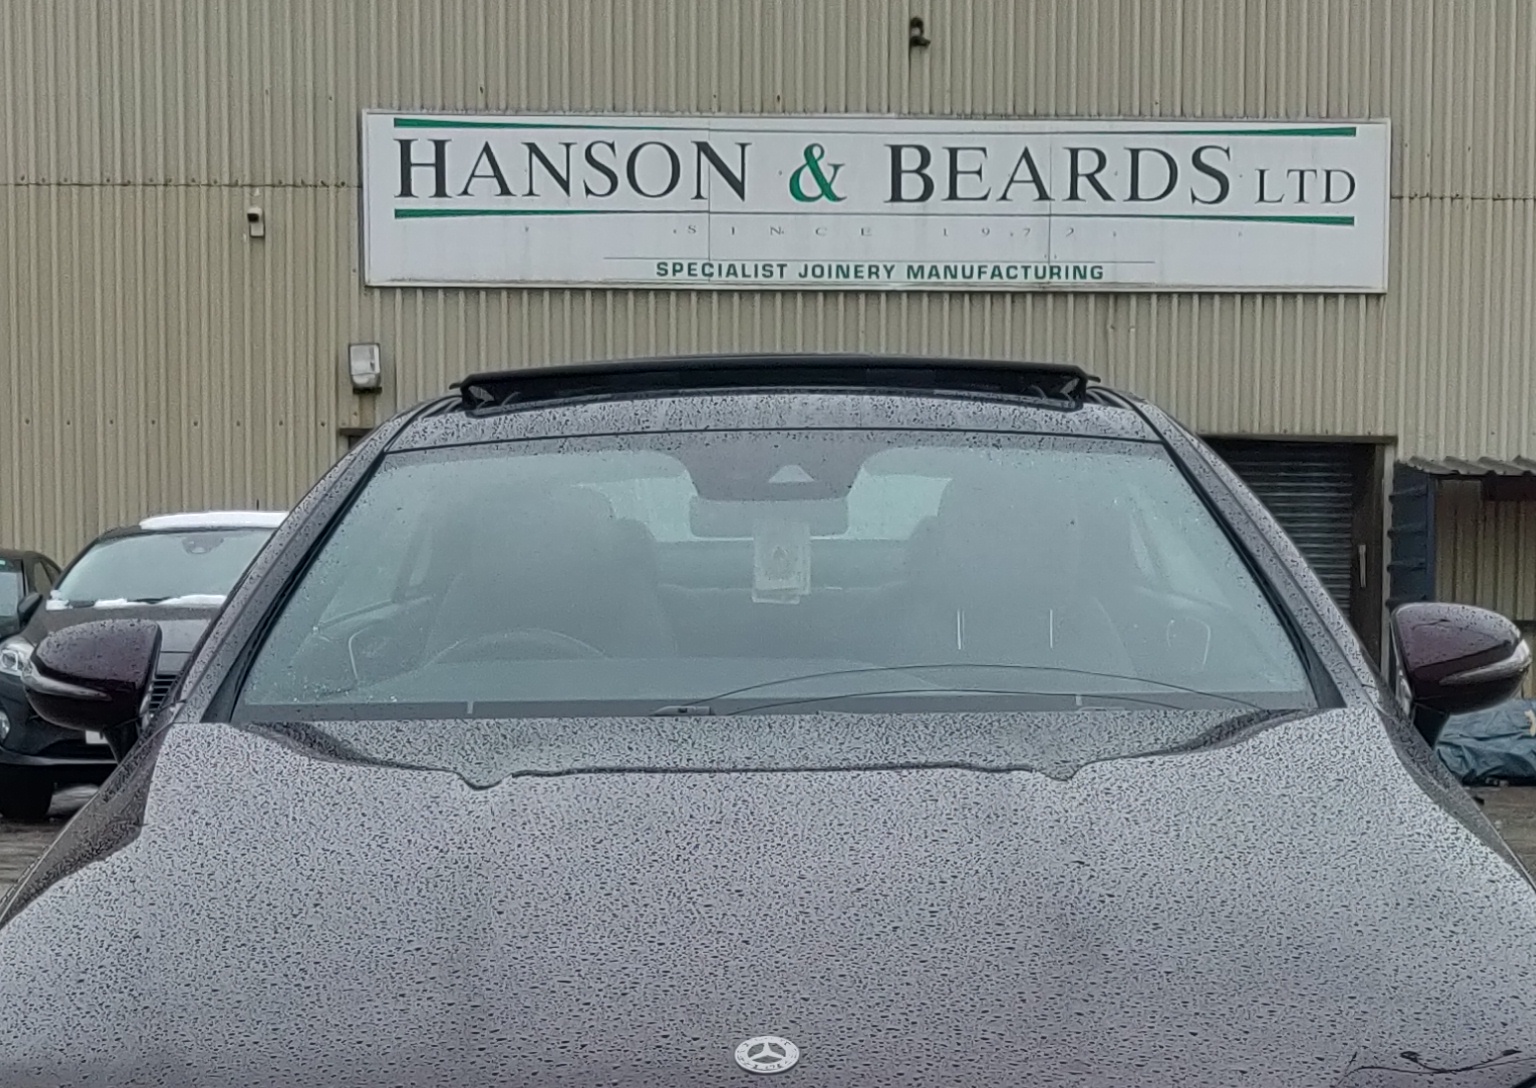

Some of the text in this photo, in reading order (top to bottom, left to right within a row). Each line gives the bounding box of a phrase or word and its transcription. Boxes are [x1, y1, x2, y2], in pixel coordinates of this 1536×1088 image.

[394, 138, 1356, 205] HANSON & BEARDS LTD
[656, 262, 1104, 280] SPECIALIST JOINERY MANUFACTURING
